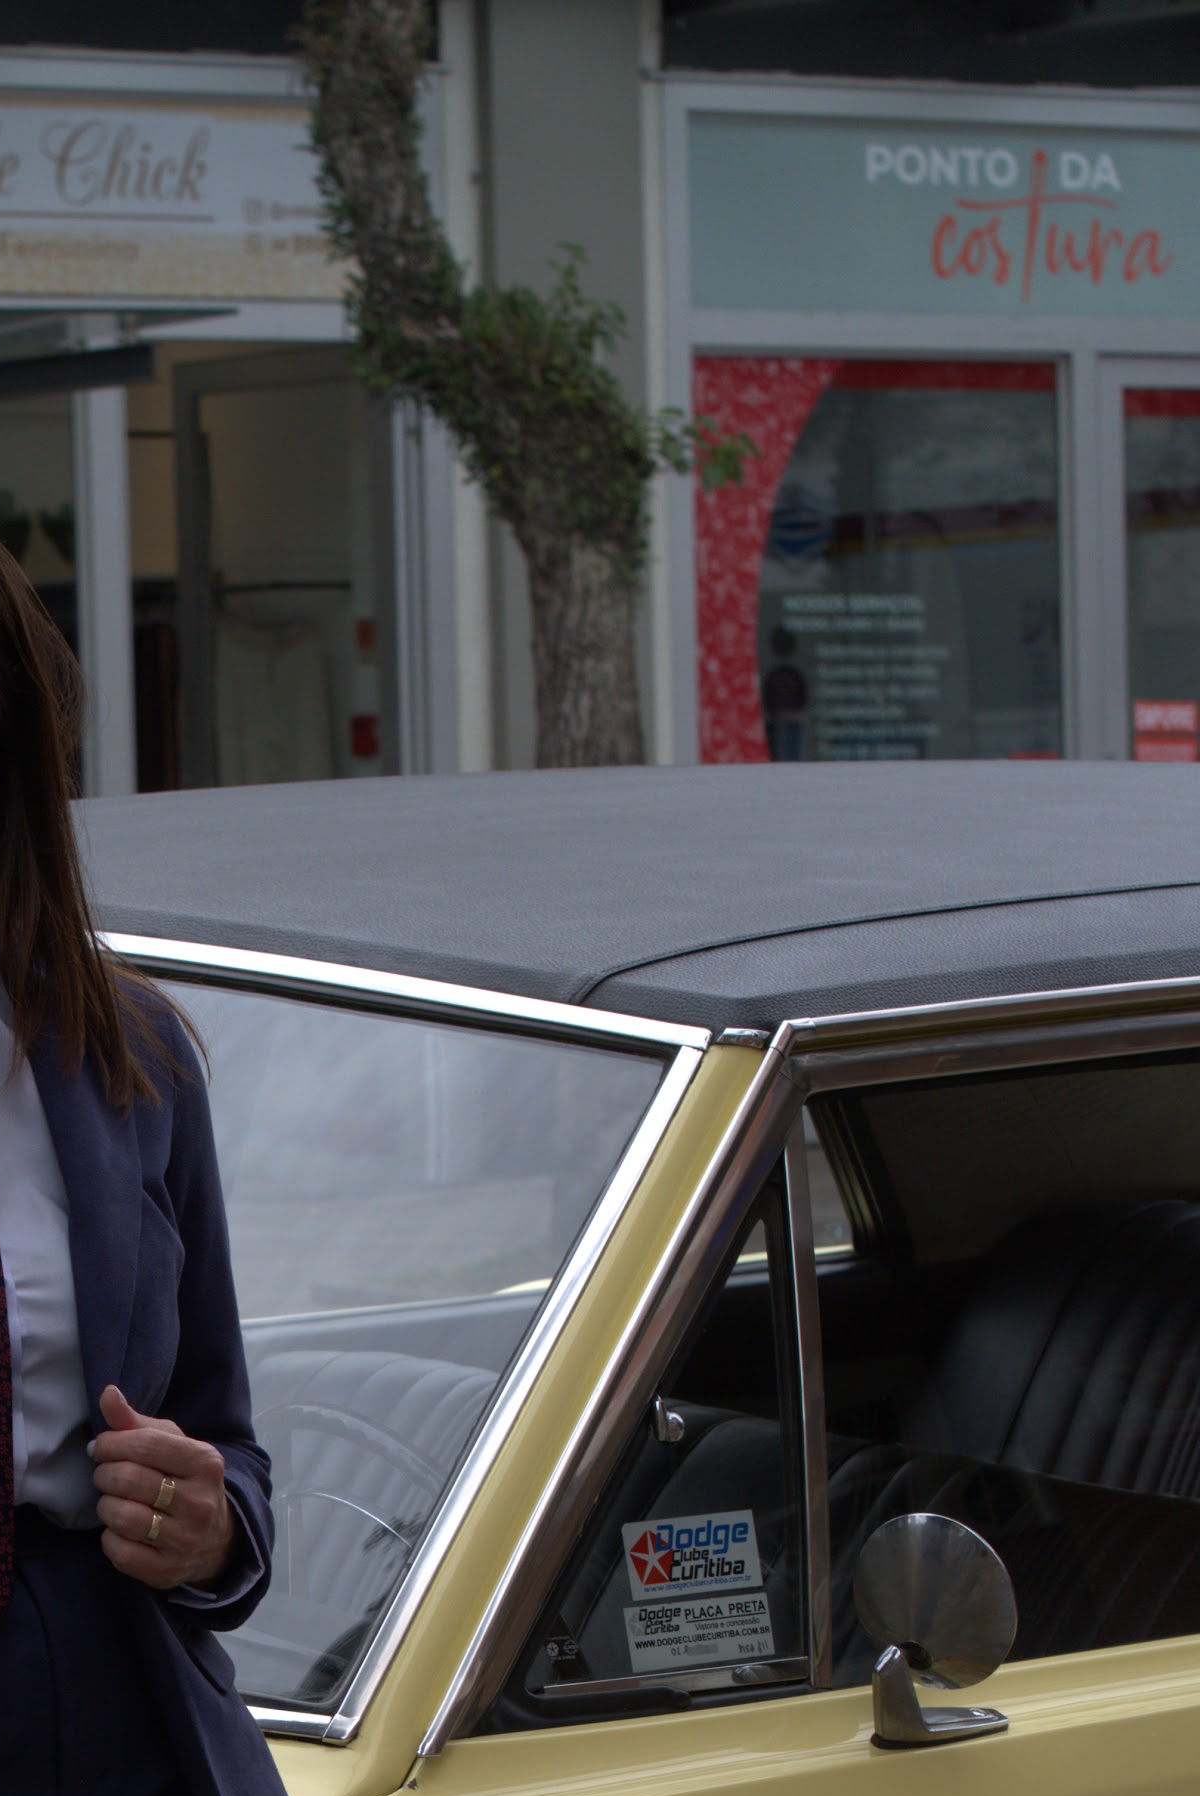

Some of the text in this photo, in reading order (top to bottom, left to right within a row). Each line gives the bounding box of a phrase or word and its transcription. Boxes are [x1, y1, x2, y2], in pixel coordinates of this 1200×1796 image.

[39, 119, 211, 206] Chick
[865, 144, 1122, 190] PONTO DA
[930, 149, 1175, 304] costura
[656, 1520, 748, 1555] Dodge
[672, 1548, 709, 1563] Clube
[668, 1557, 745, 1581] Curitiba
[644, 1574, 752, 1592] www.dodgeclubecuritiba.com.br
[639, 1606, 681, 1622] Dodge
[684, 1600, 766, 1620] PLACA PRETA
[644, 1623, 680, 1635] Curitiba
[695, 1622, 718, 1631] Vistoria
[726, 1617, 760, 1628] concessão
[635, 1627, 770, 1649] WWW.DODGECLUBECURITIBA.COM.BR
